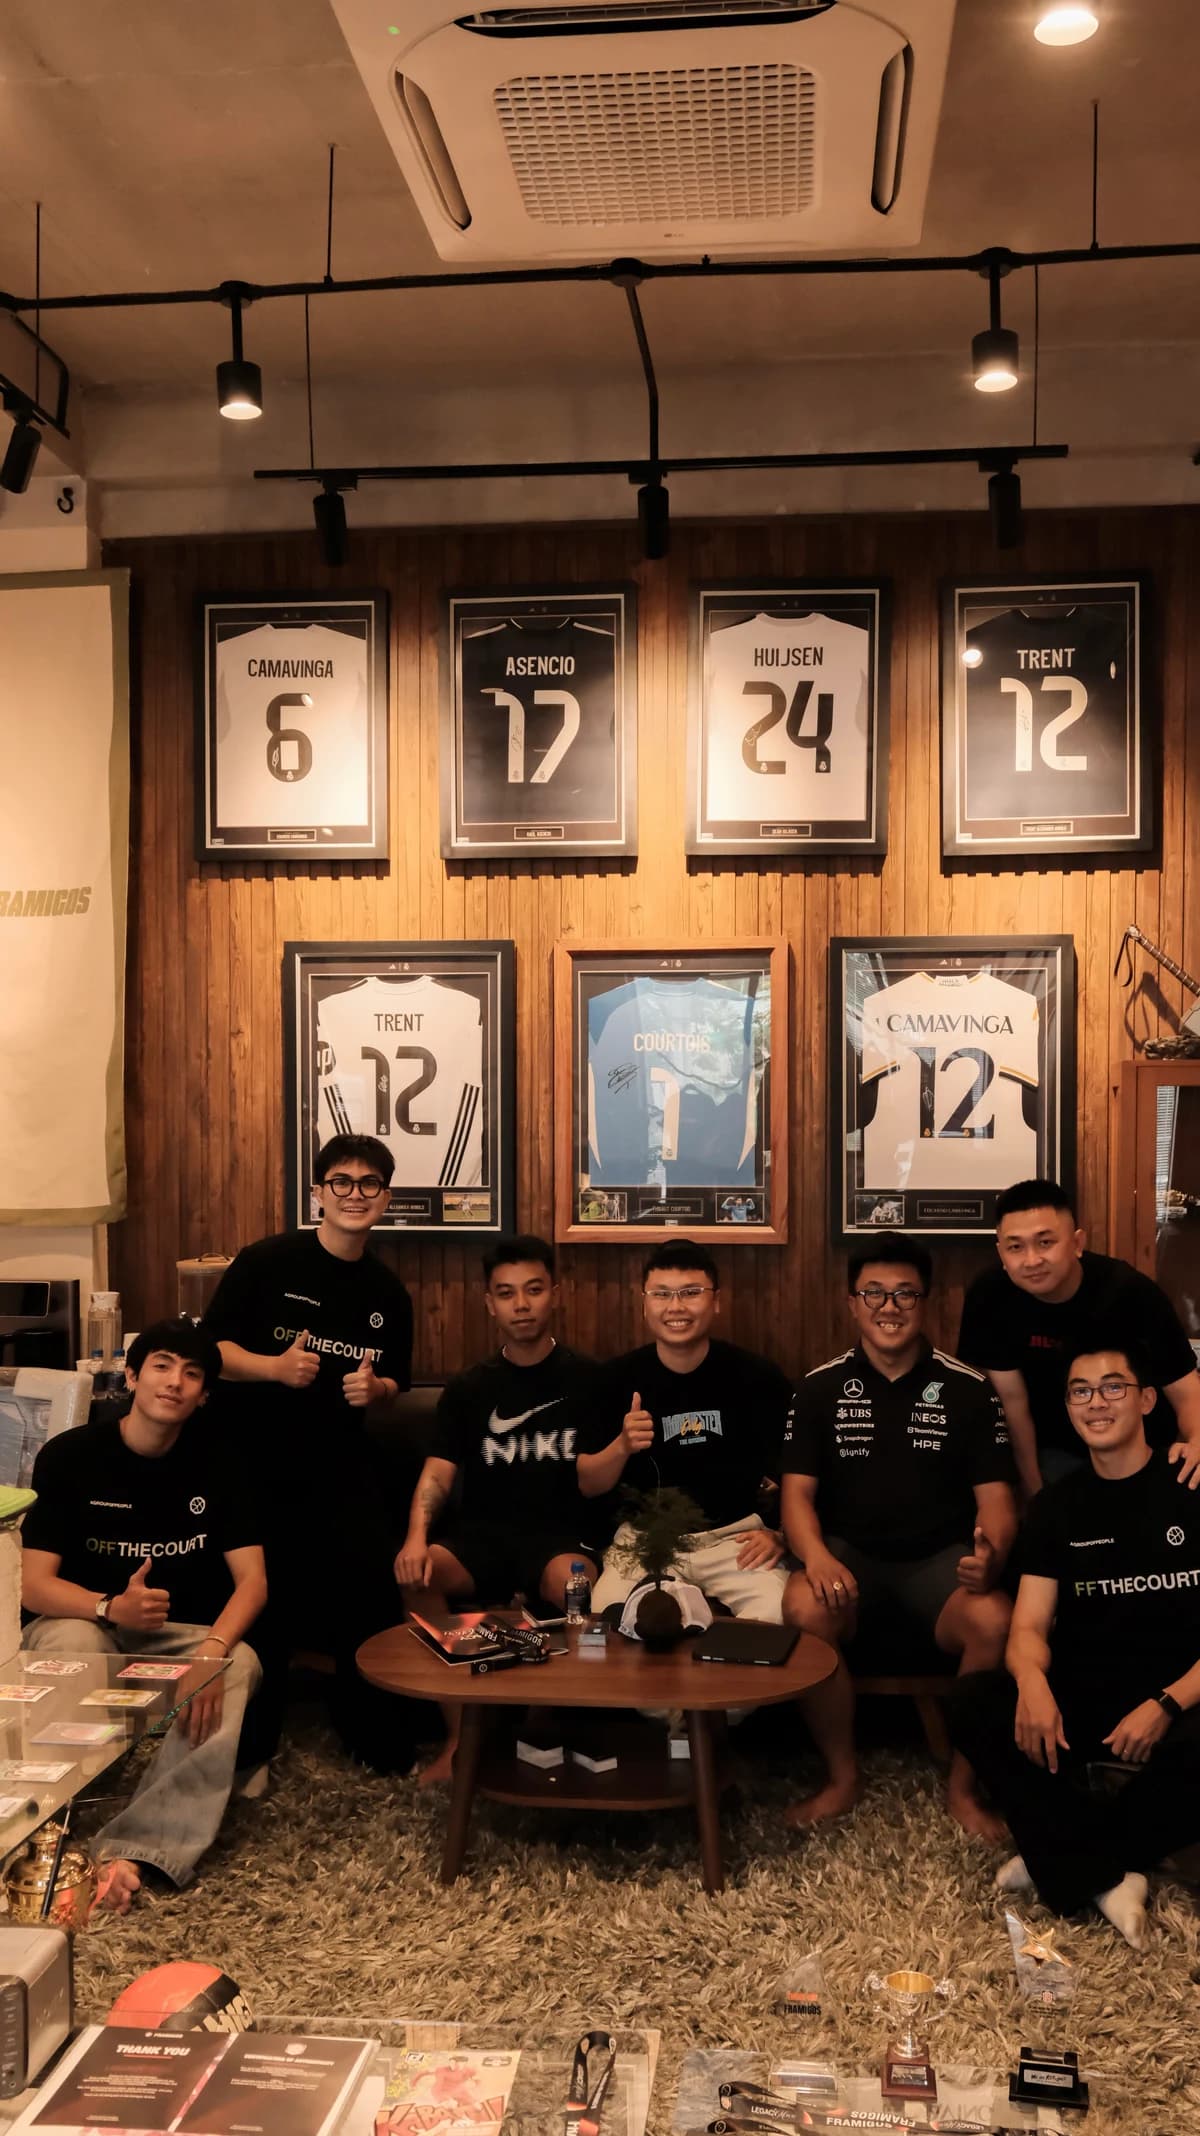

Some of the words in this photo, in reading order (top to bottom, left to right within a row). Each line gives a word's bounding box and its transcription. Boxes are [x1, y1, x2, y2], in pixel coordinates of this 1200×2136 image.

[505, 656, 575, 676] ASENCIO
[753, 646, 824, 667] HUIJSEN
[1016, 647, 1076, 670] TRENT
[247, 658, 334, 679] CAMAVINGA
[742, 680, 834, 774] 24
[1000, 675, 1088, 771] 12
[266, 692, 313, 782] 6
[494, 689, 581, 783] 17
[373, 1013, 424, 1032] TRENT
[887, 1014, 1014, 1035] CAMAVINGA
[633, 1032, 711, 1052] COURTOIS
[361, 1046, 438, 1136] 12
[908, 1046, 995, 1138] 12
[649, 1067, 681, 1160] 1
[850, 1408, 872, 1418] UBS
[911, 1412, 947, 1425] INEOS
[481, 1427, 577, 1466] NIKE
[913, 1439, 942, 1451] HPE
[116, 2044, 162, 2055] THANK
[163, 2046, 192, 2057] YOU
[850, 2110, 917, 2128] FRAMIGOS
